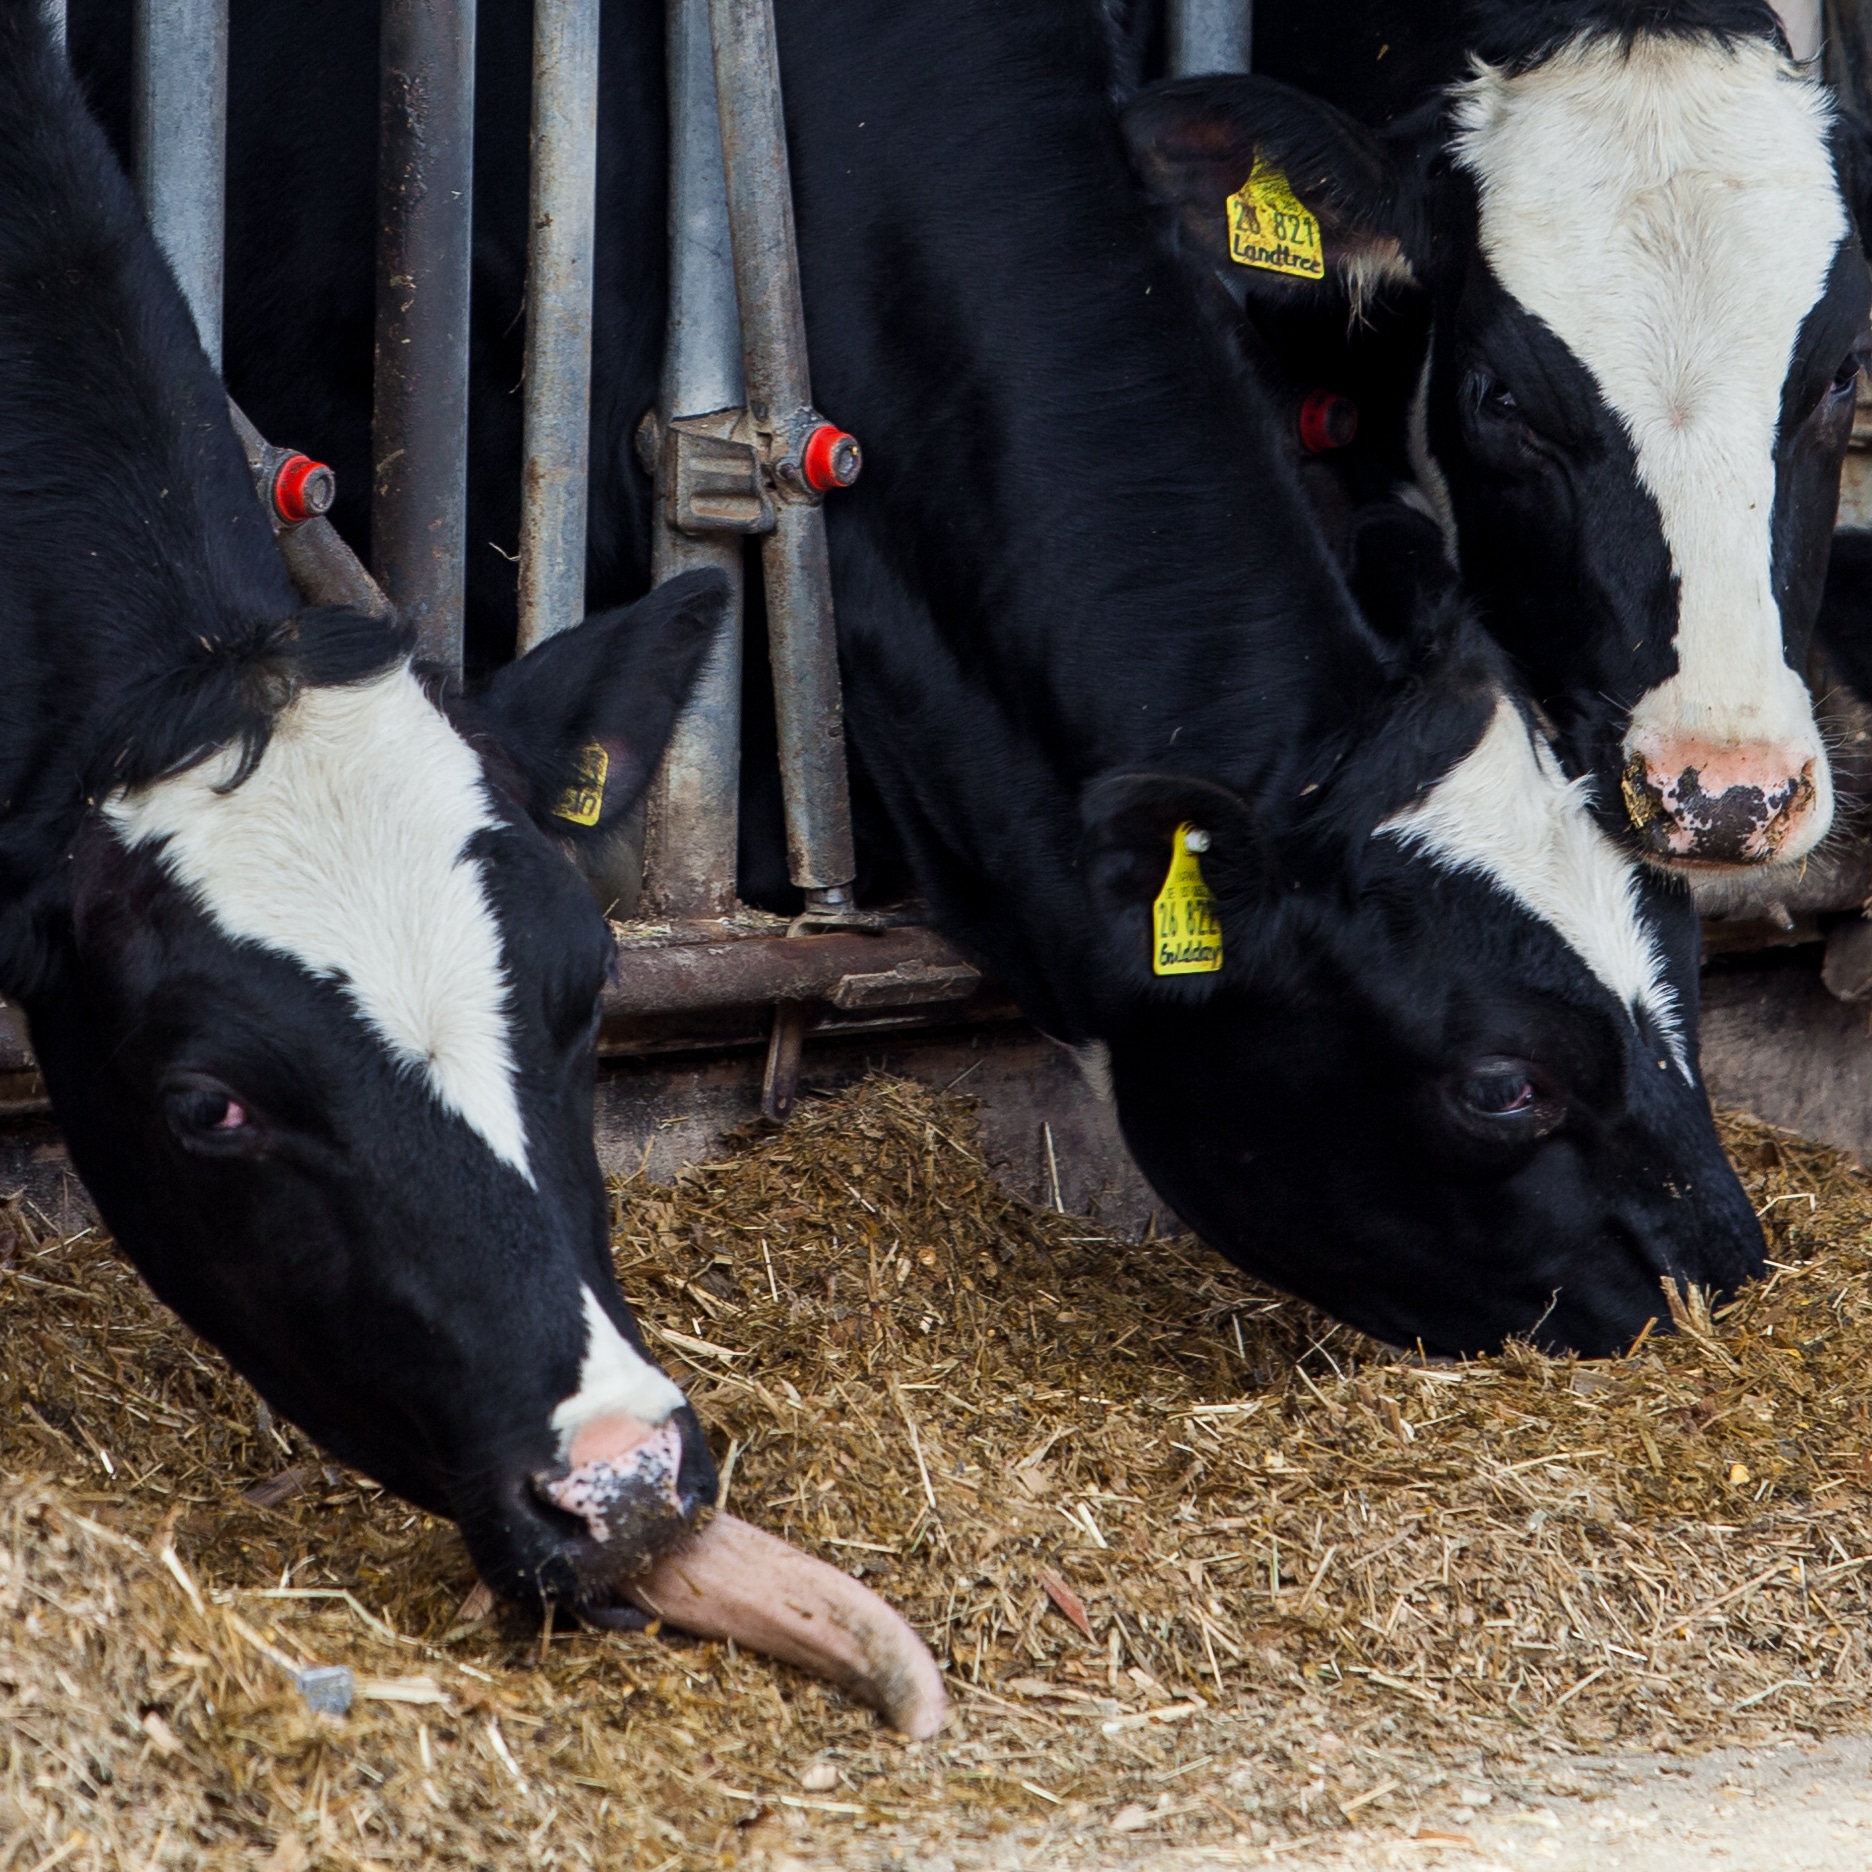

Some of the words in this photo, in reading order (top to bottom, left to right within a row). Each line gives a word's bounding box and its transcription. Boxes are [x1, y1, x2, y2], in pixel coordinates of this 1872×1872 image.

[1274, 211, 1315, 247] 821
[1233, 232, 1322, 274] Landtree
[1158, 902, 1178, 938] 26
